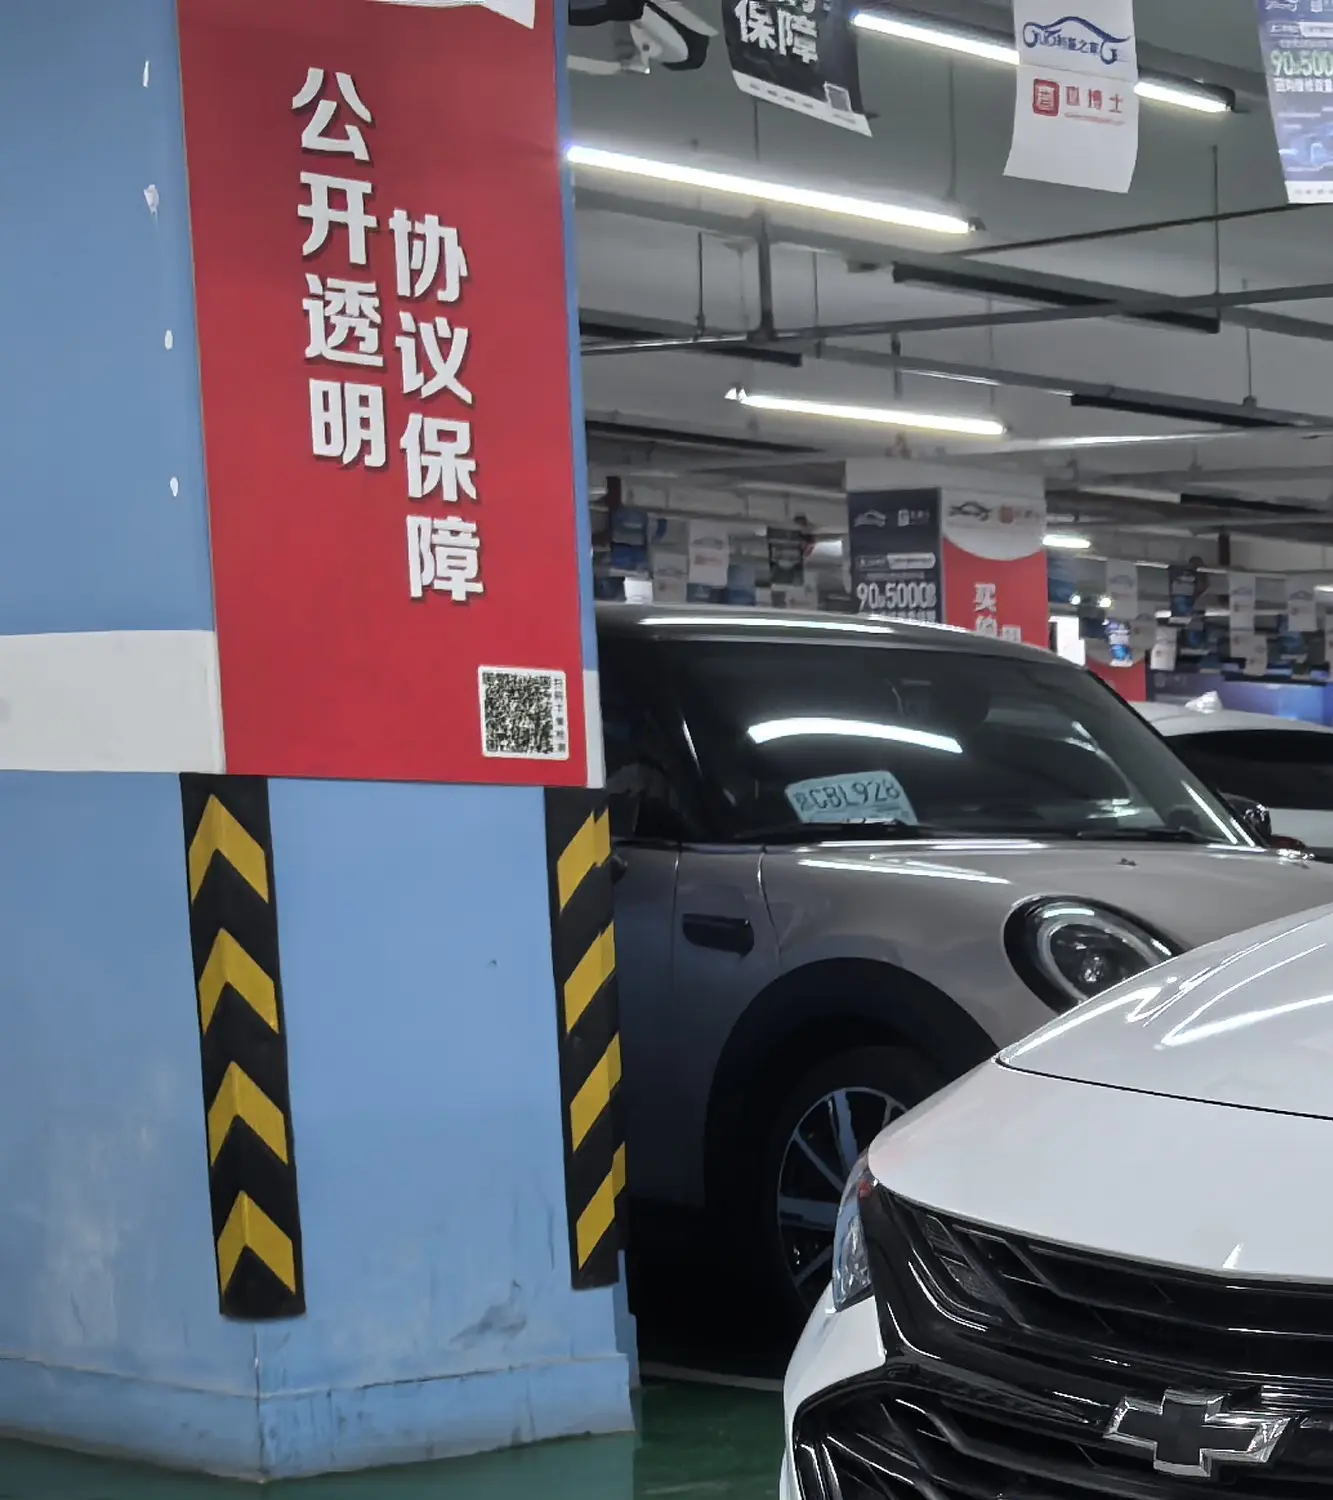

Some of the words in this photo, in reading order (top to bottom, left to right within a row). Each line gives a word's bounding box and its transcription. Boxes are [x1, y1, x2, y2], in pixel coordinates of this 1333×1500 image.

[734, 0, 819, 64] 保障
[292, 66, 388, 469] 公开透明
[389, 207, 485, 604] 协议保障
